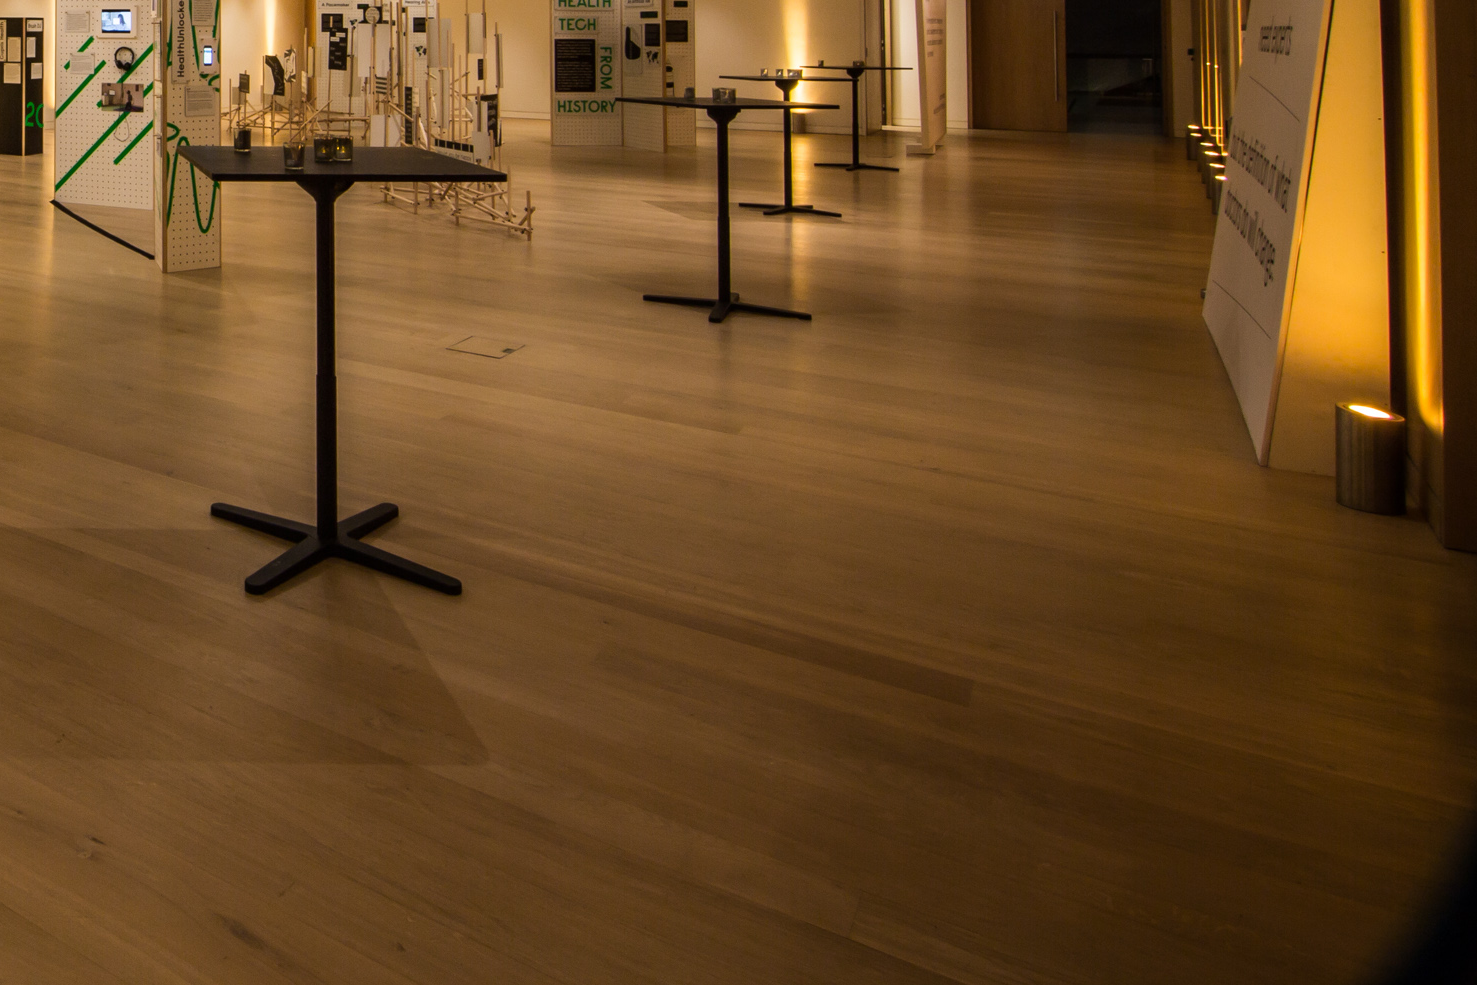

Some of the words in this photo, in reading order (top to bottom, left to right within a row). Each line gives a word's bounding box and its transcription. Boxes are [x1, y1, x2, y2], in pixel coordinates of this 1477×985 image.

[559, 18, 596, 31] TECH
[600, 46, 612, 89] FROM
[557, 100, 616, 113] HISTORY
